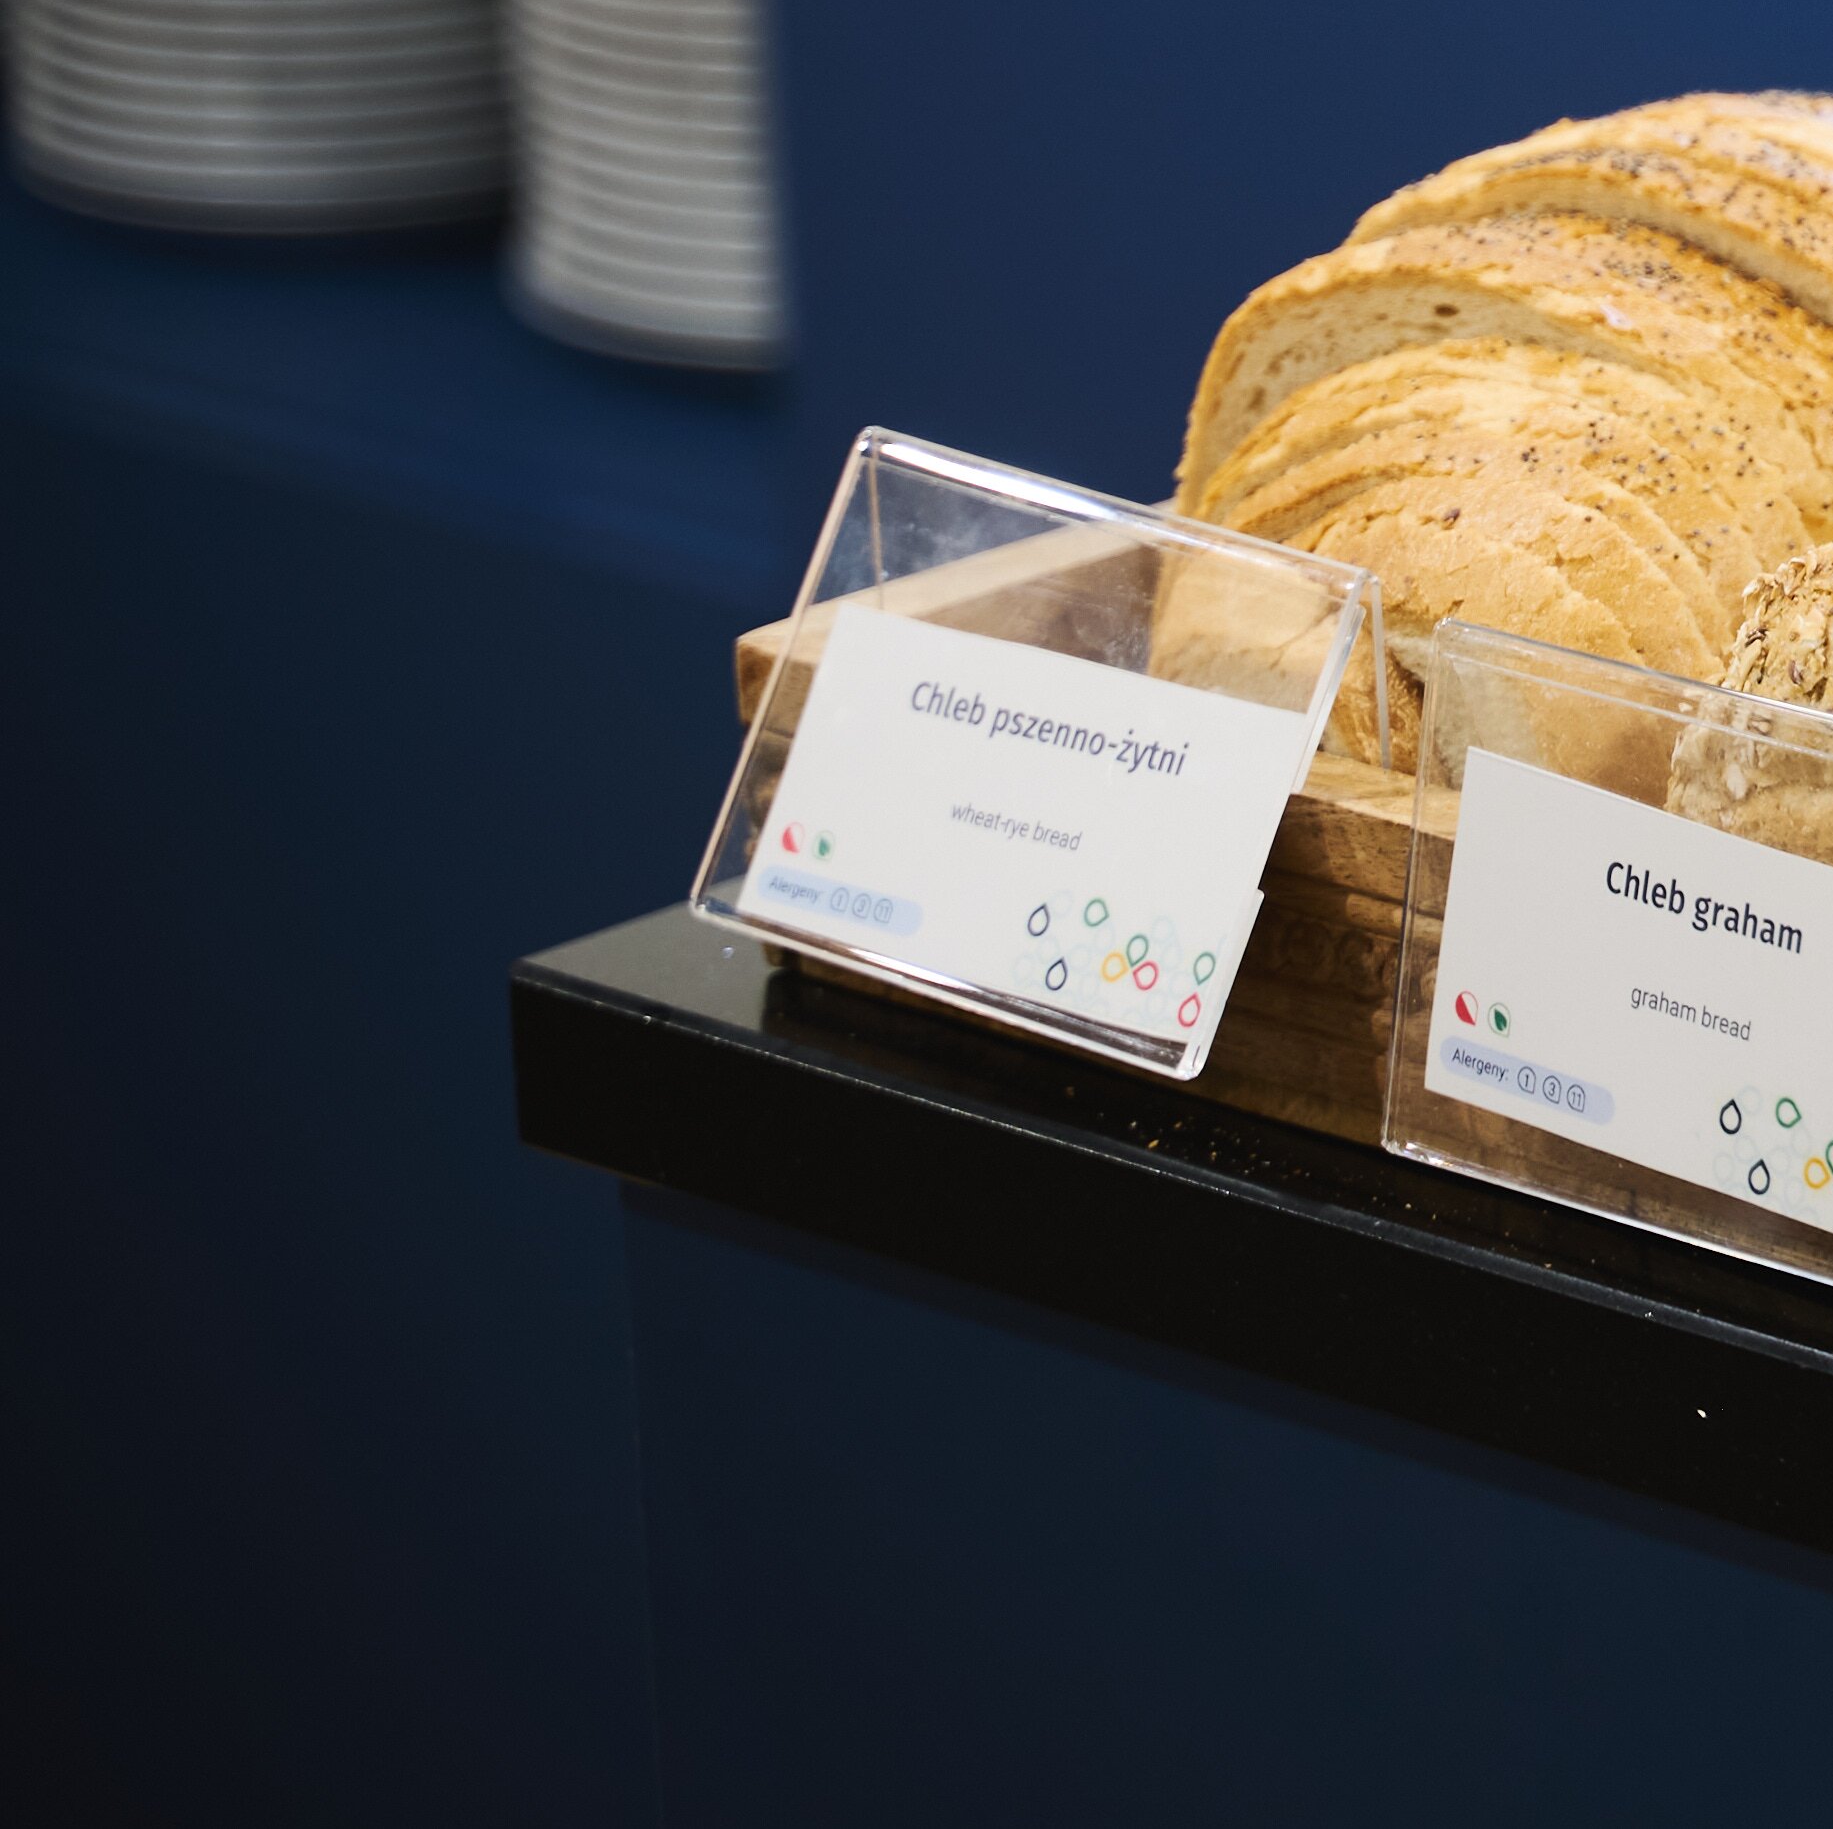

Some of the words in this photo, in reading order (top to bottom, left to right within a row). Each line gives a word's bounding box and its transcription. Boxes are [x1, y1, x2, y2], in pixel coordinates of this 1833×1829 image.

[911, 681, 987, 726] Chleb
[989, 706, 1190, 776] pszenno-żytni
[950, 802, 1030, 840] wheat-rye
[1032, 820, 1083, 852] bread
[1606, 861, 1686, 914] Chleb
[1692, 896, 1803, 954] graham
[1630, 986, 1697, 1024] graham
[1701, 1004, 1752, 1042] bread
[1452, 1047, 1510, 1082] Alergeny:
